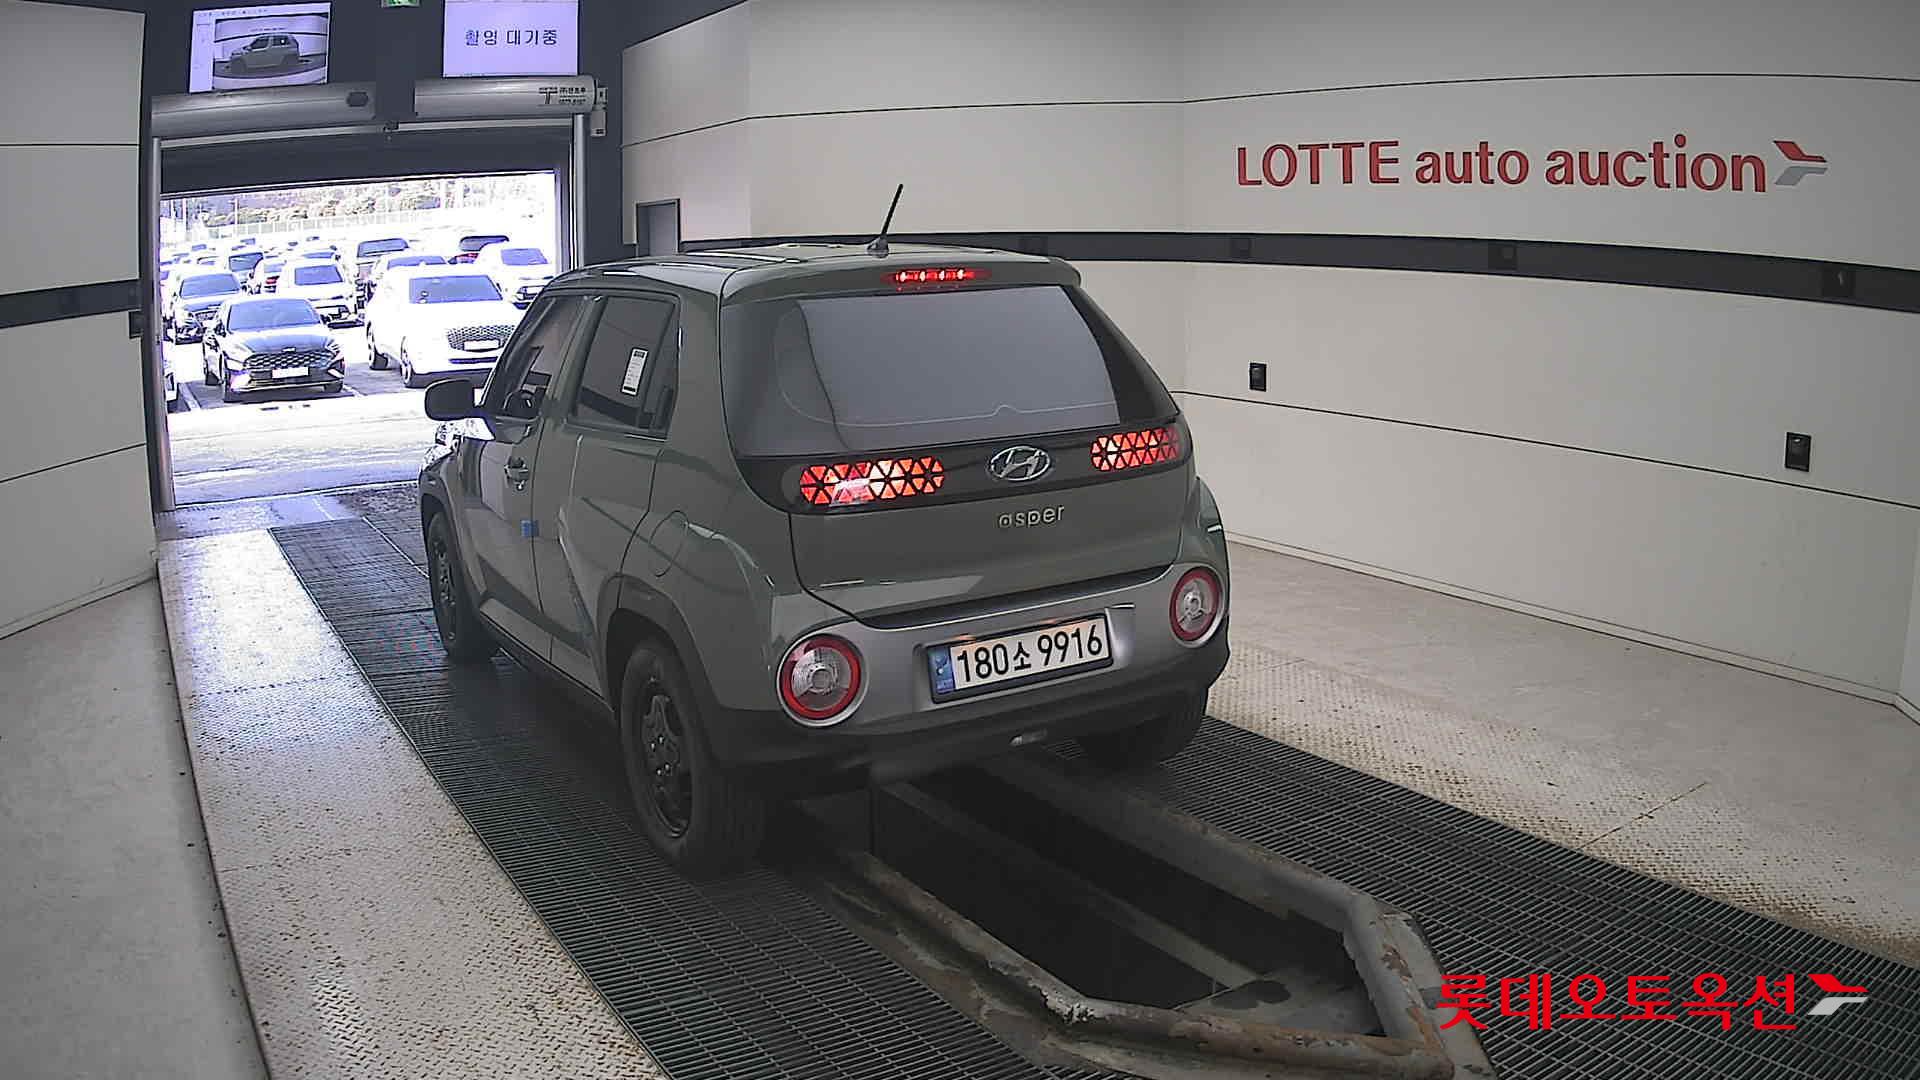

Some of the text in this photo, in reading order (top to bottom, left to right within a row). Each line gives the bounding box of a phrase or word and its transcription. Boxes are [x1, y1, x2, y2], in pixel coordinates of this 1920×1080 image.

[506, 29, 557, 46] 대기중
[1237, 133, 1767, 193] LOTTE auto auction
[957, 624, 1103, 682] 180소 9916
